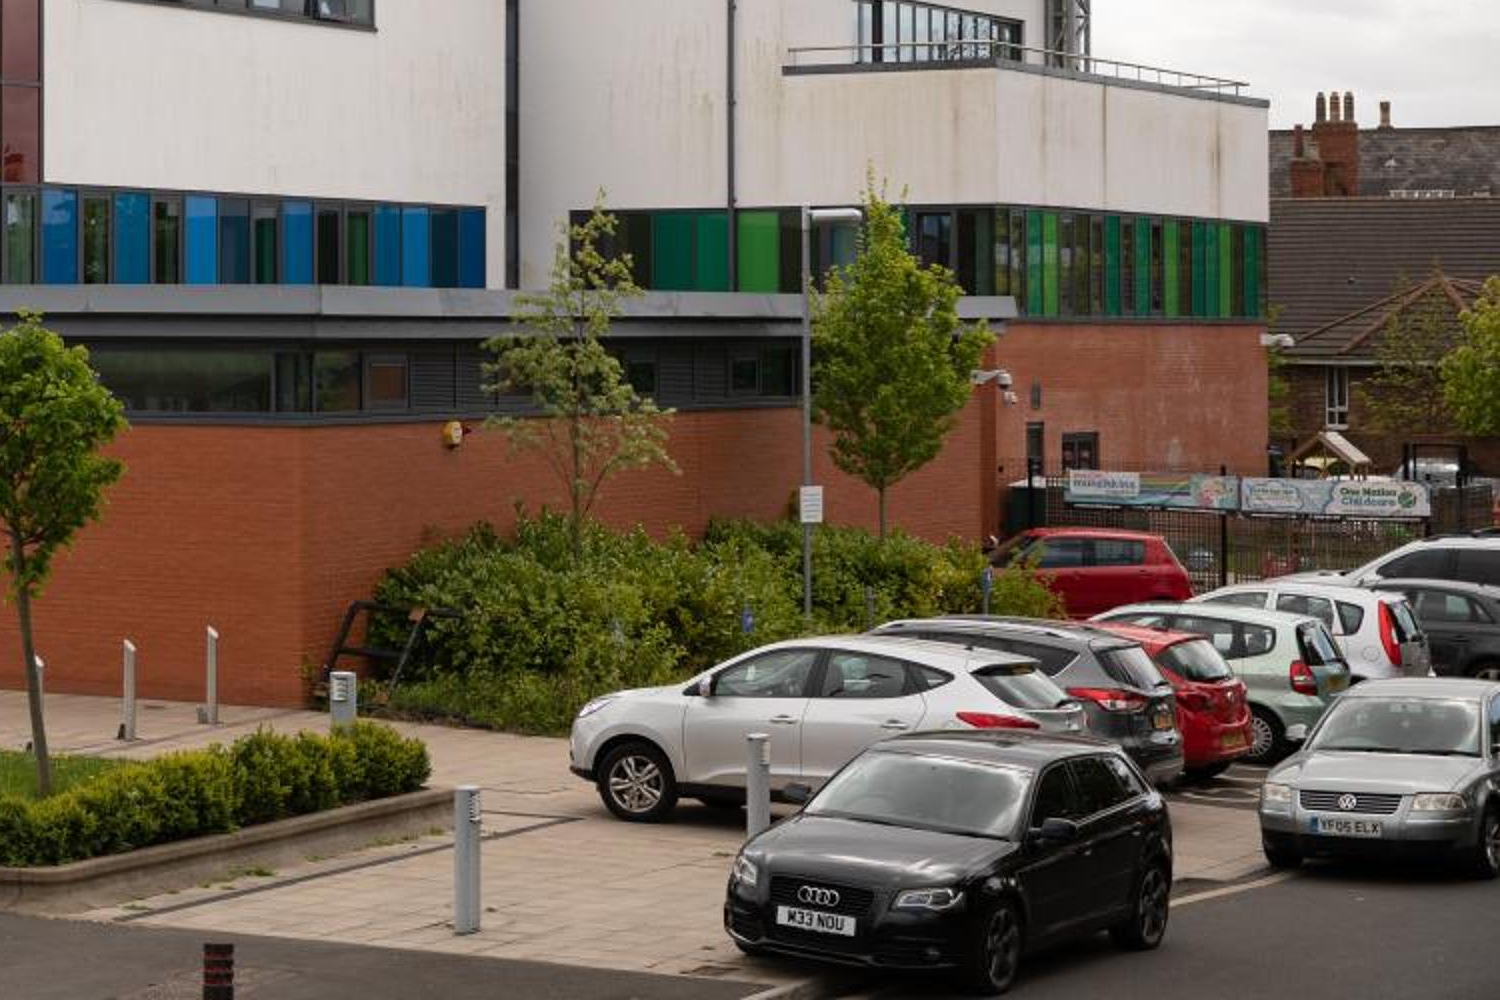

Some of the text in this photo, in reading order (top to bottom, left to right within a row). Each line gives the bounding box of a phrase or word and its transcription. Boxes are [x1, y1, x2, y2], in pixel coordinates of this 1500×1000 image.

[1340, 487, 1397, 497] One Nation
[1341, 496, 1397, 506] Childcare
[1355, 821, 1379, 834] ELX
[787, 910, 814, 927] M33
